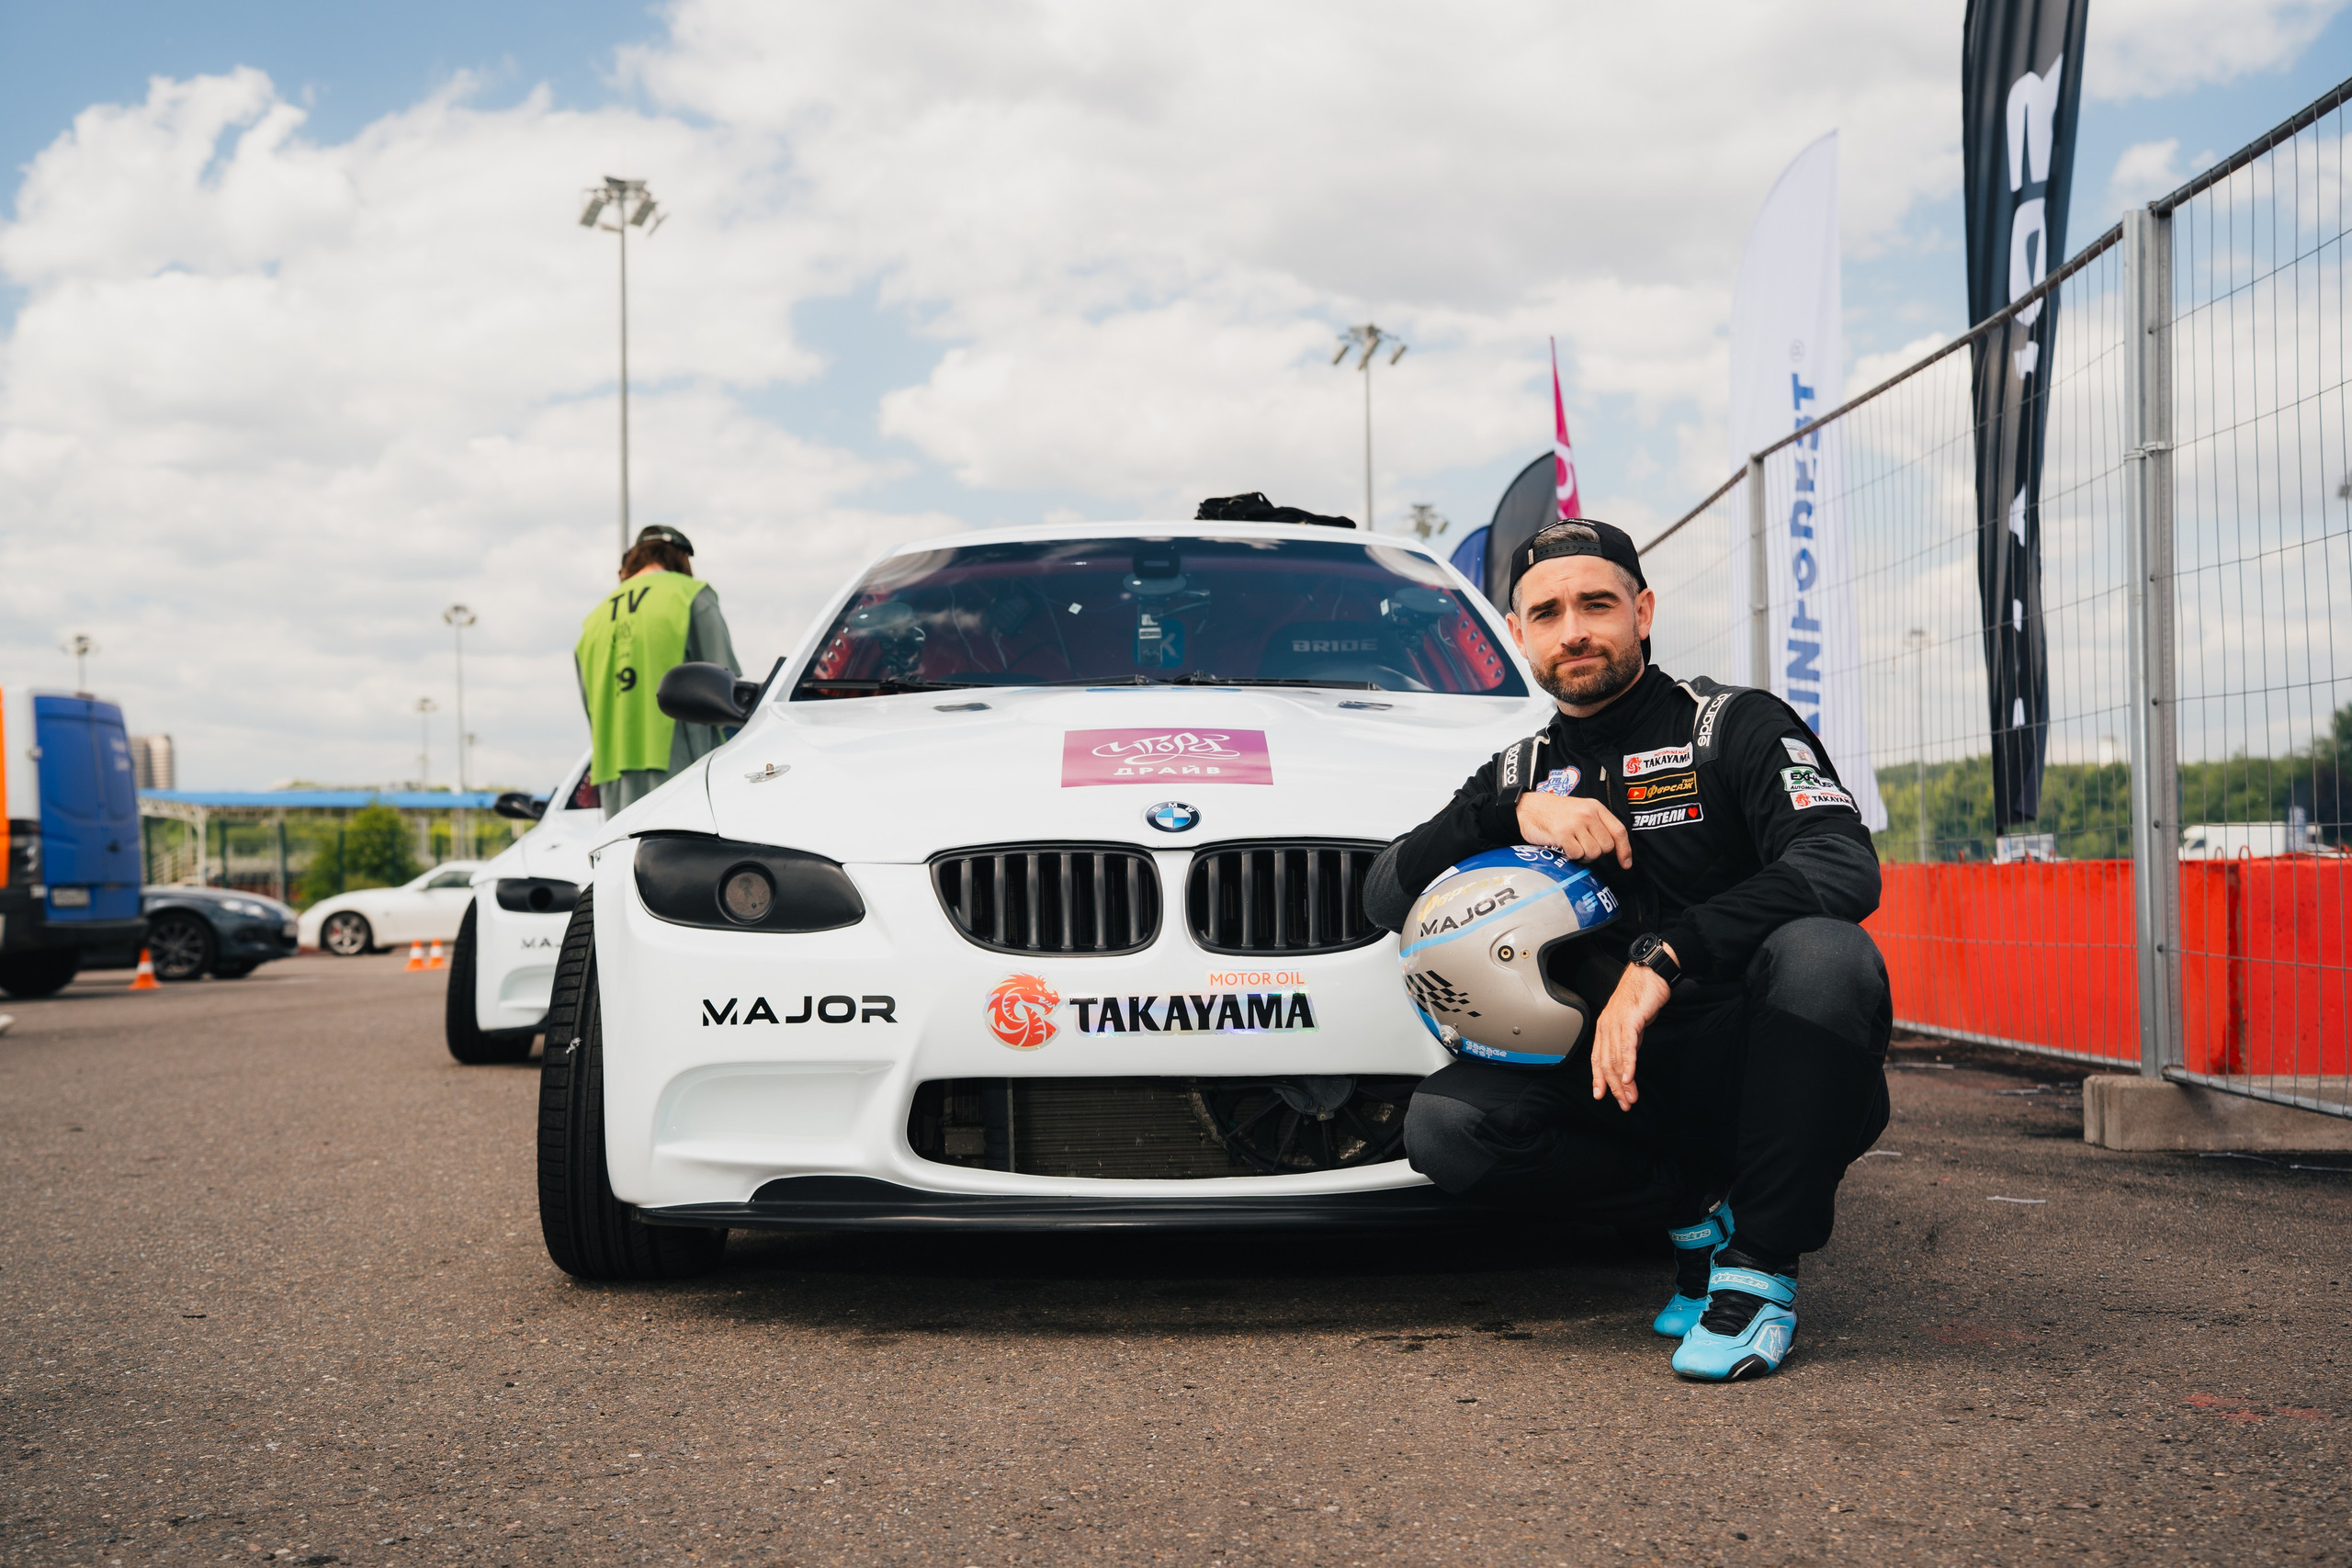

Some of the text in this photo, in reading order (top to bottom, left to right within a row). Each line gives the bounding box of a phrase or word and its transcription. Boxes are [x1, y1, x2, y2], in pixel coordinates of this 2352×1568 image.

[610, 586, 651, 621] TV
[1292, 638, 1378, 653] BRIDE
[1697, 693, 1733, 747] sparco
[1114, 765, 1221, 775] ДРАЙВ
[1503, 742, 1521, 786] sparco
[1643, 751, 1690, 769] TAKAYAMA
[1152, 802, 1195, 813] BMW
[1633, 808, 1687, 827] ЗРИТЕЛИ
[1419, 887, 1520, 937] MAJOR
[1210, 972, 1305, 986] MOTOR OIL
[702, 995, 899, 1026] MAJOR
[1069, 993, 1316, 1032] TAKAYAMA
